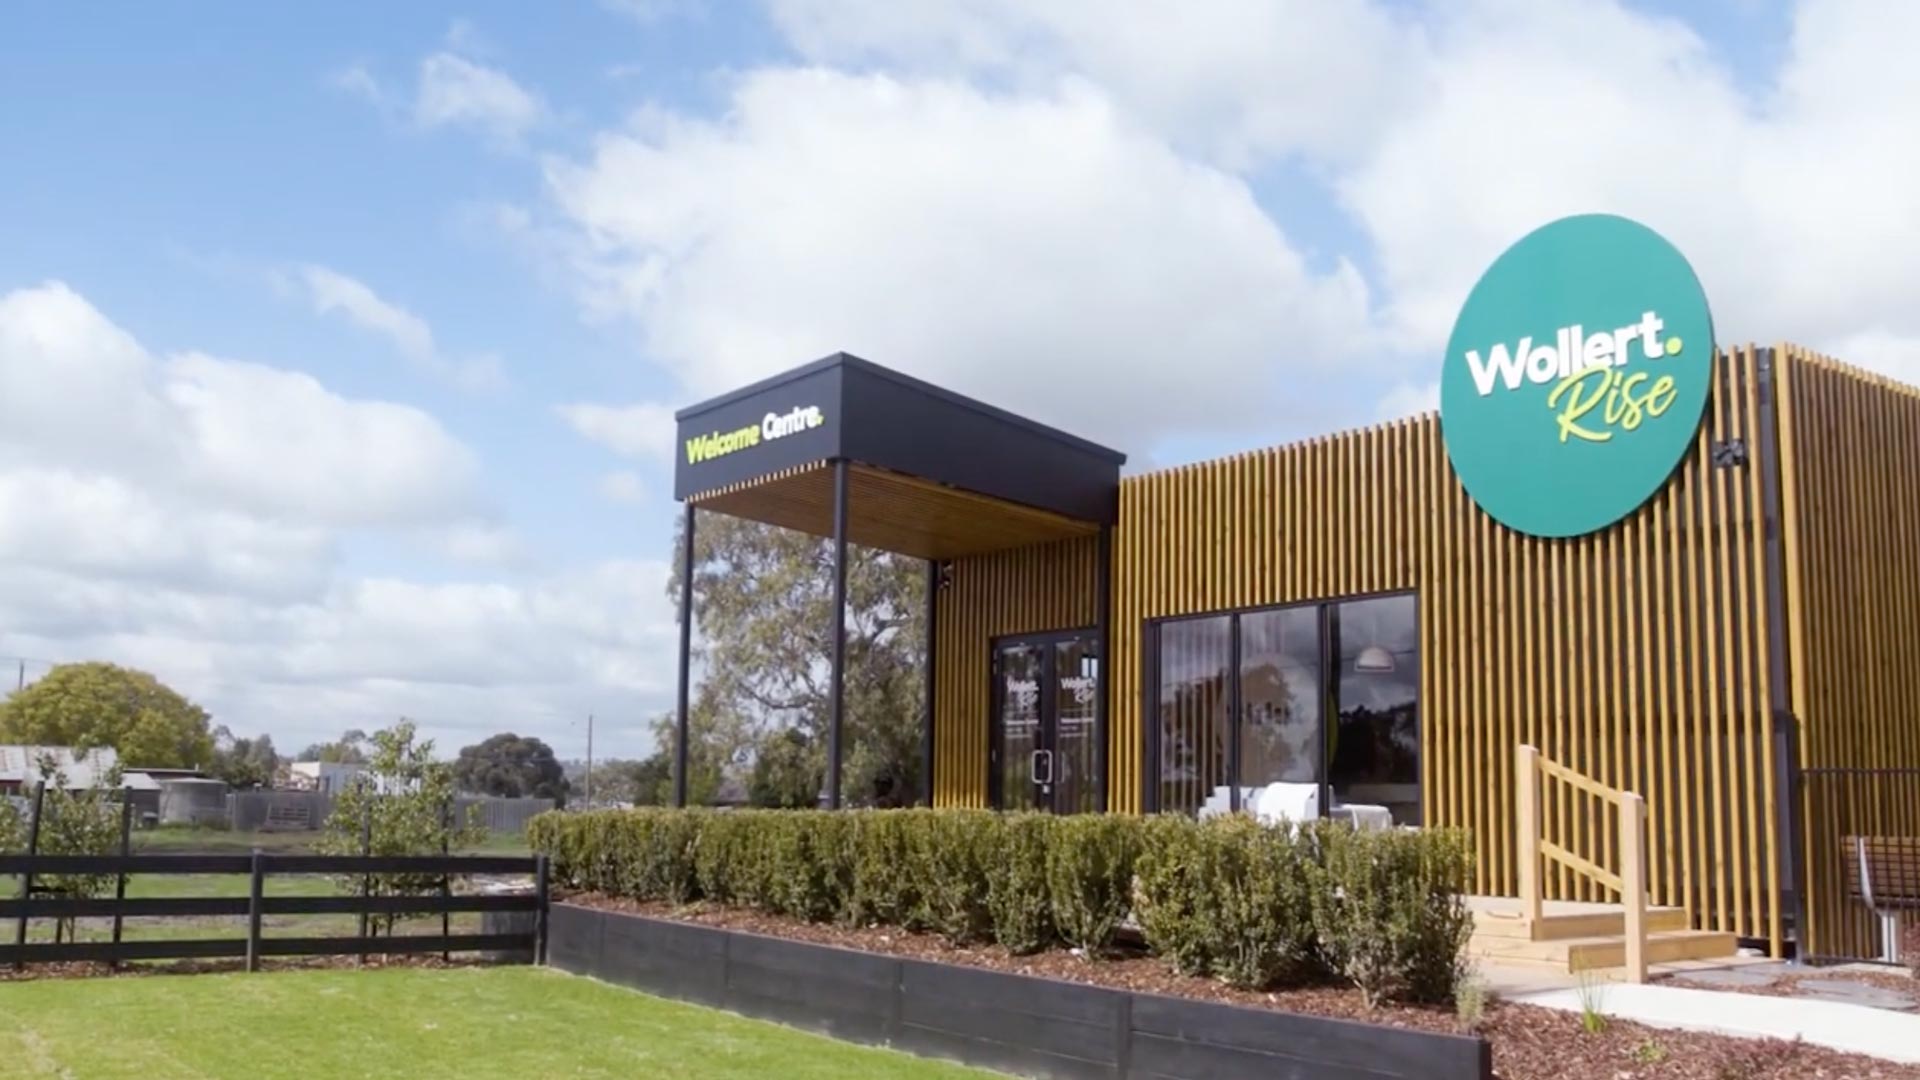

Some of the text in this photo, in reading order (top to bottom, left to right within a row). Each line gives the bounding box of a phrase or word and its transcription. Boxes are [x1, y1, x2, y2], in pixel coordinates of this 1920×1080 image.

[1464, 310, 1682, 397] Wollert.
[685, 405, 825, 465] Welcome Centre.
[1547, 361, 1678, 442] Rise
